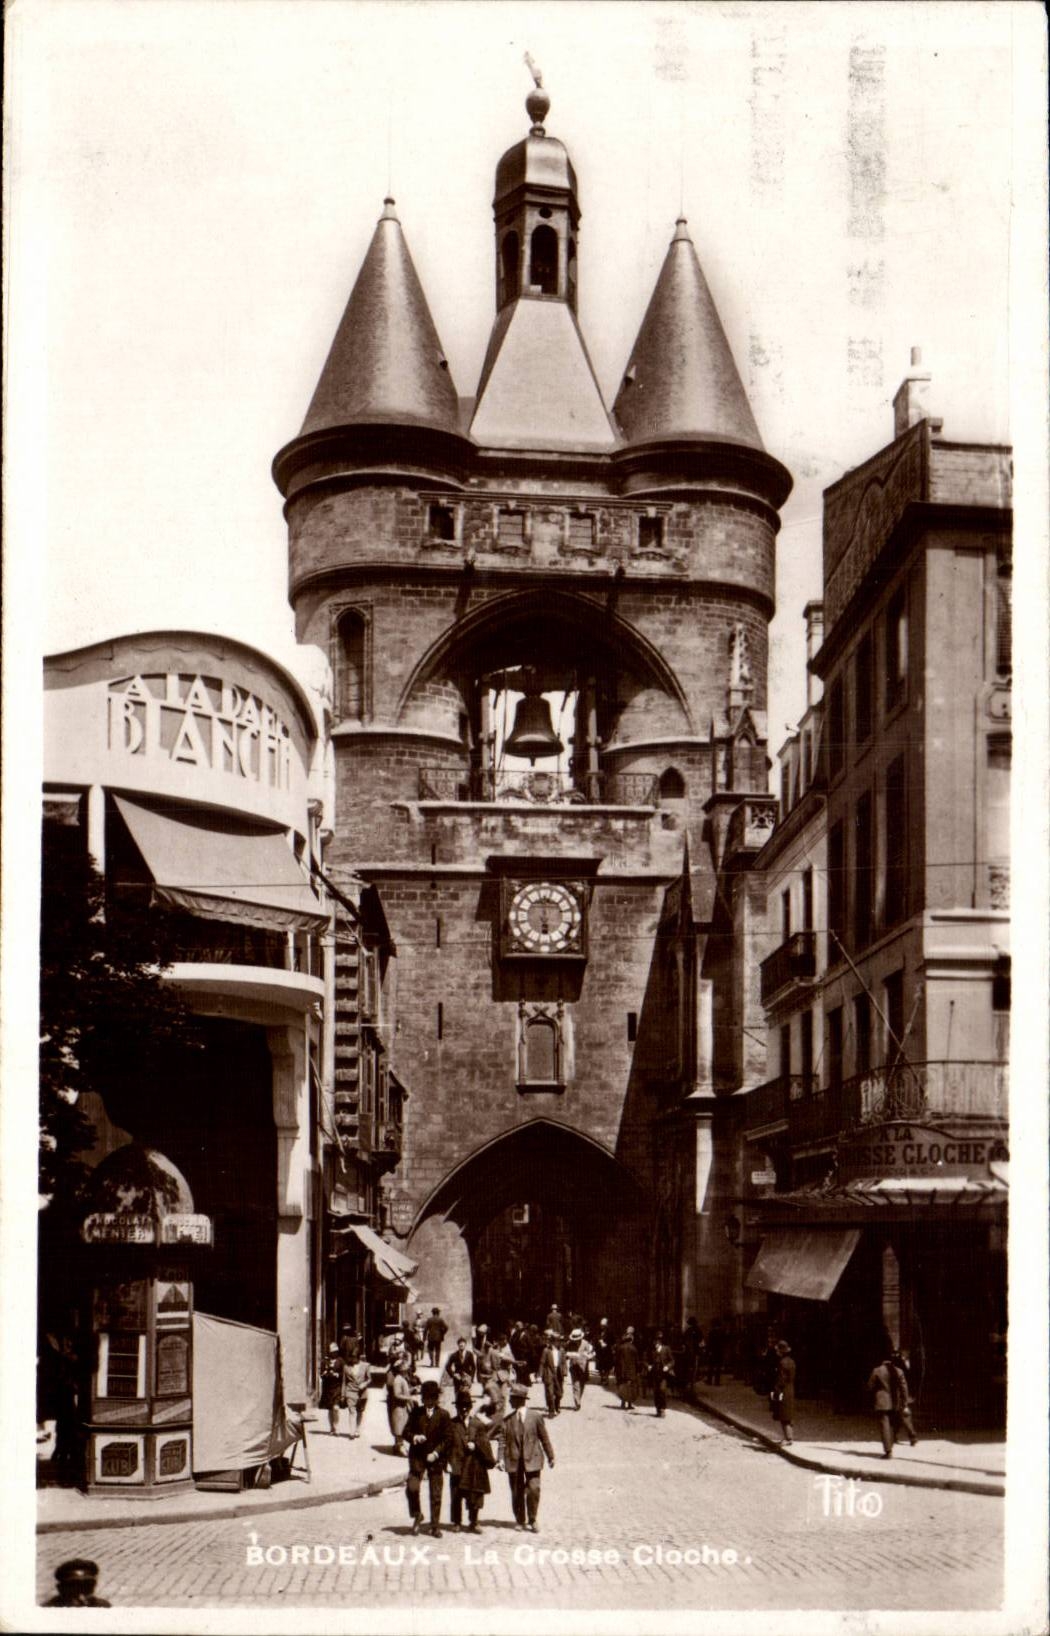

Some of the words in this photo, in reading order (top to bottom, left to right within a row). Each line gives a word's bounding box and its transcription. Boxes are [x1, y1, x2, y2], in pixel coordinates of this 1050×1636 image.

[165, 673, 217, 715] LA
[108, 696, 294, 790] BLANCHE
[902, 1143, 986, 1165] CLOCHE
